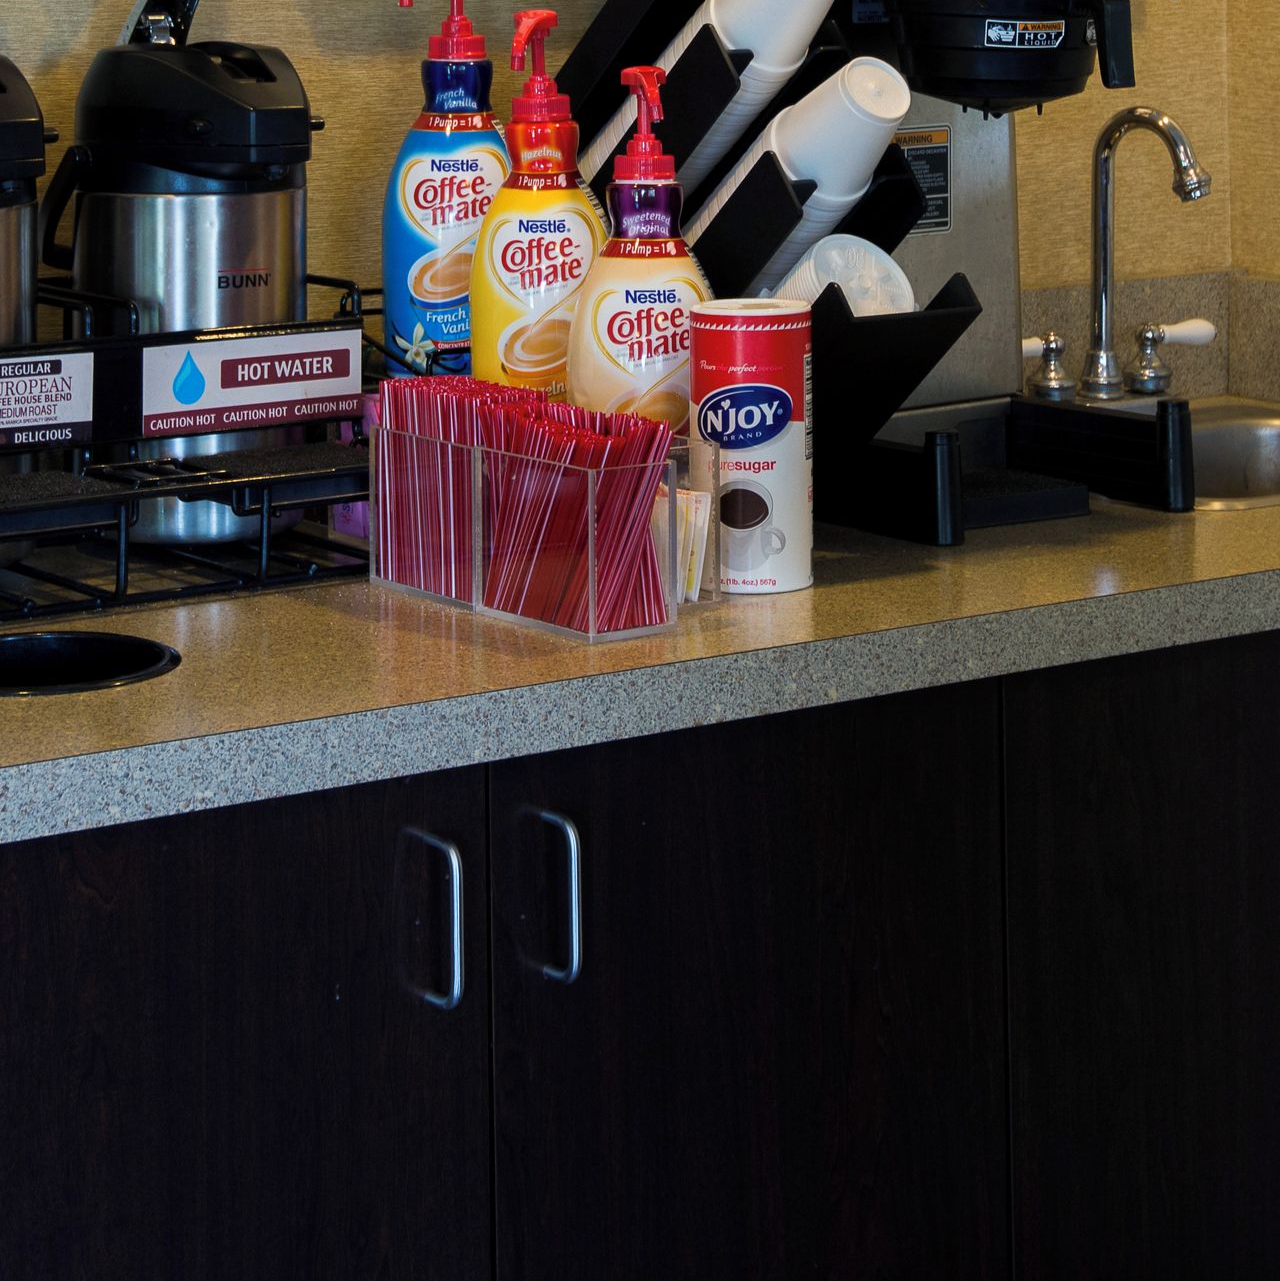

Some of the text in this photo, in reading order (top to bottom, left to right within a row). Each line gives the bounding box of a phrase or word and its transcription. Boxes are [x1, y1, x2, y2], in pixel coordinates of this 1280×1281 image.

[1030, 23, 1062, 31] WARNING
[1025, 32, 1057, 40] HOT
[436, 88, 465, 104] French
[444, 97, 477, 110] Vanilla
[434, 117, 458, 129] Pump
[895, 134, 933, 145] WARNING
[521, 147, 562, 161] Hazelnut
[523, 177, 545, 189] Pump
[431, 196, 492, 226] mate
[622, 211, 671, 228] Sweetened
[629, 223, 669, 237] Original
[625, 243, 651, 256] Pump
[520, 257, 582, 290] mate
[218, 274, 269, 289] BUNN
[426, 308, 466, 324] French
[442, 322, 470, 335] Vani
[438, 340, 470, 350] CONCENTRAT
[627, 328, 690, 362] mate
[1, 362, 51, 377] REGULAR
[237, 357, 333, 382] HOT WATER
[700, 360, 717, 371] Pours
[728, 363, 757, 374] perfect
[14, 394, 42, 405] HOUSE
[45, 392, 72, 403] BLEND
[28, 404, 58, 417] ROAST
[223, 406, 288, 423] CAUTION HOT
[294, 399, 358, 416] CAUTION HOT
[150, 413, 216, 431] CAUTION HOT
[14, 428, 72, 443] DELICIOUS
[723, 431, 762, 442] BRAND
[760, 578, 776, 586] 567g
